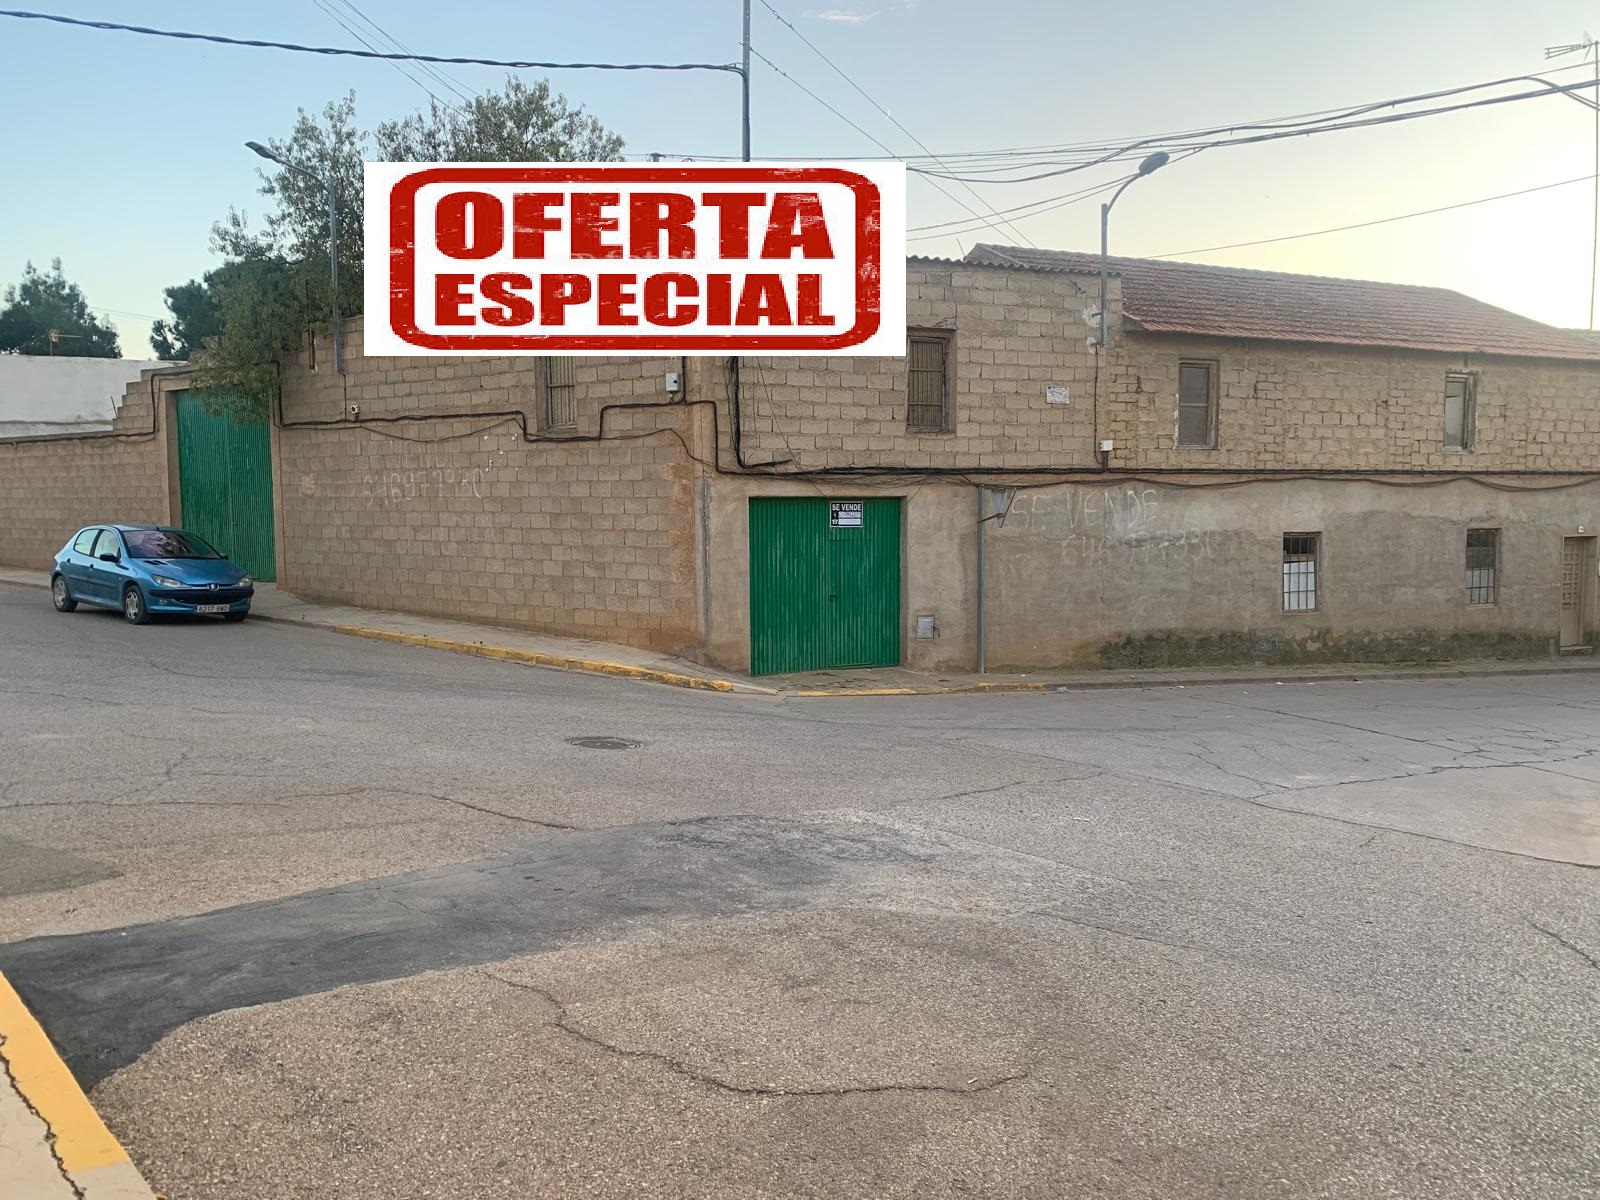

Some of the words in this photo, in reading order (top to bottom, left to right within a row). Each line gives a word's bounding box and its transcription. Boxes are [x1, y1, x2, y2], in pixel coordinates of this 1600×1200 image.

[832, 503, 840, 511] SE
[841, 503, 862, 511] VENDE
[1011, 494, 1051, 532] SE
[1066, 487, 1158, 529] VENDE
